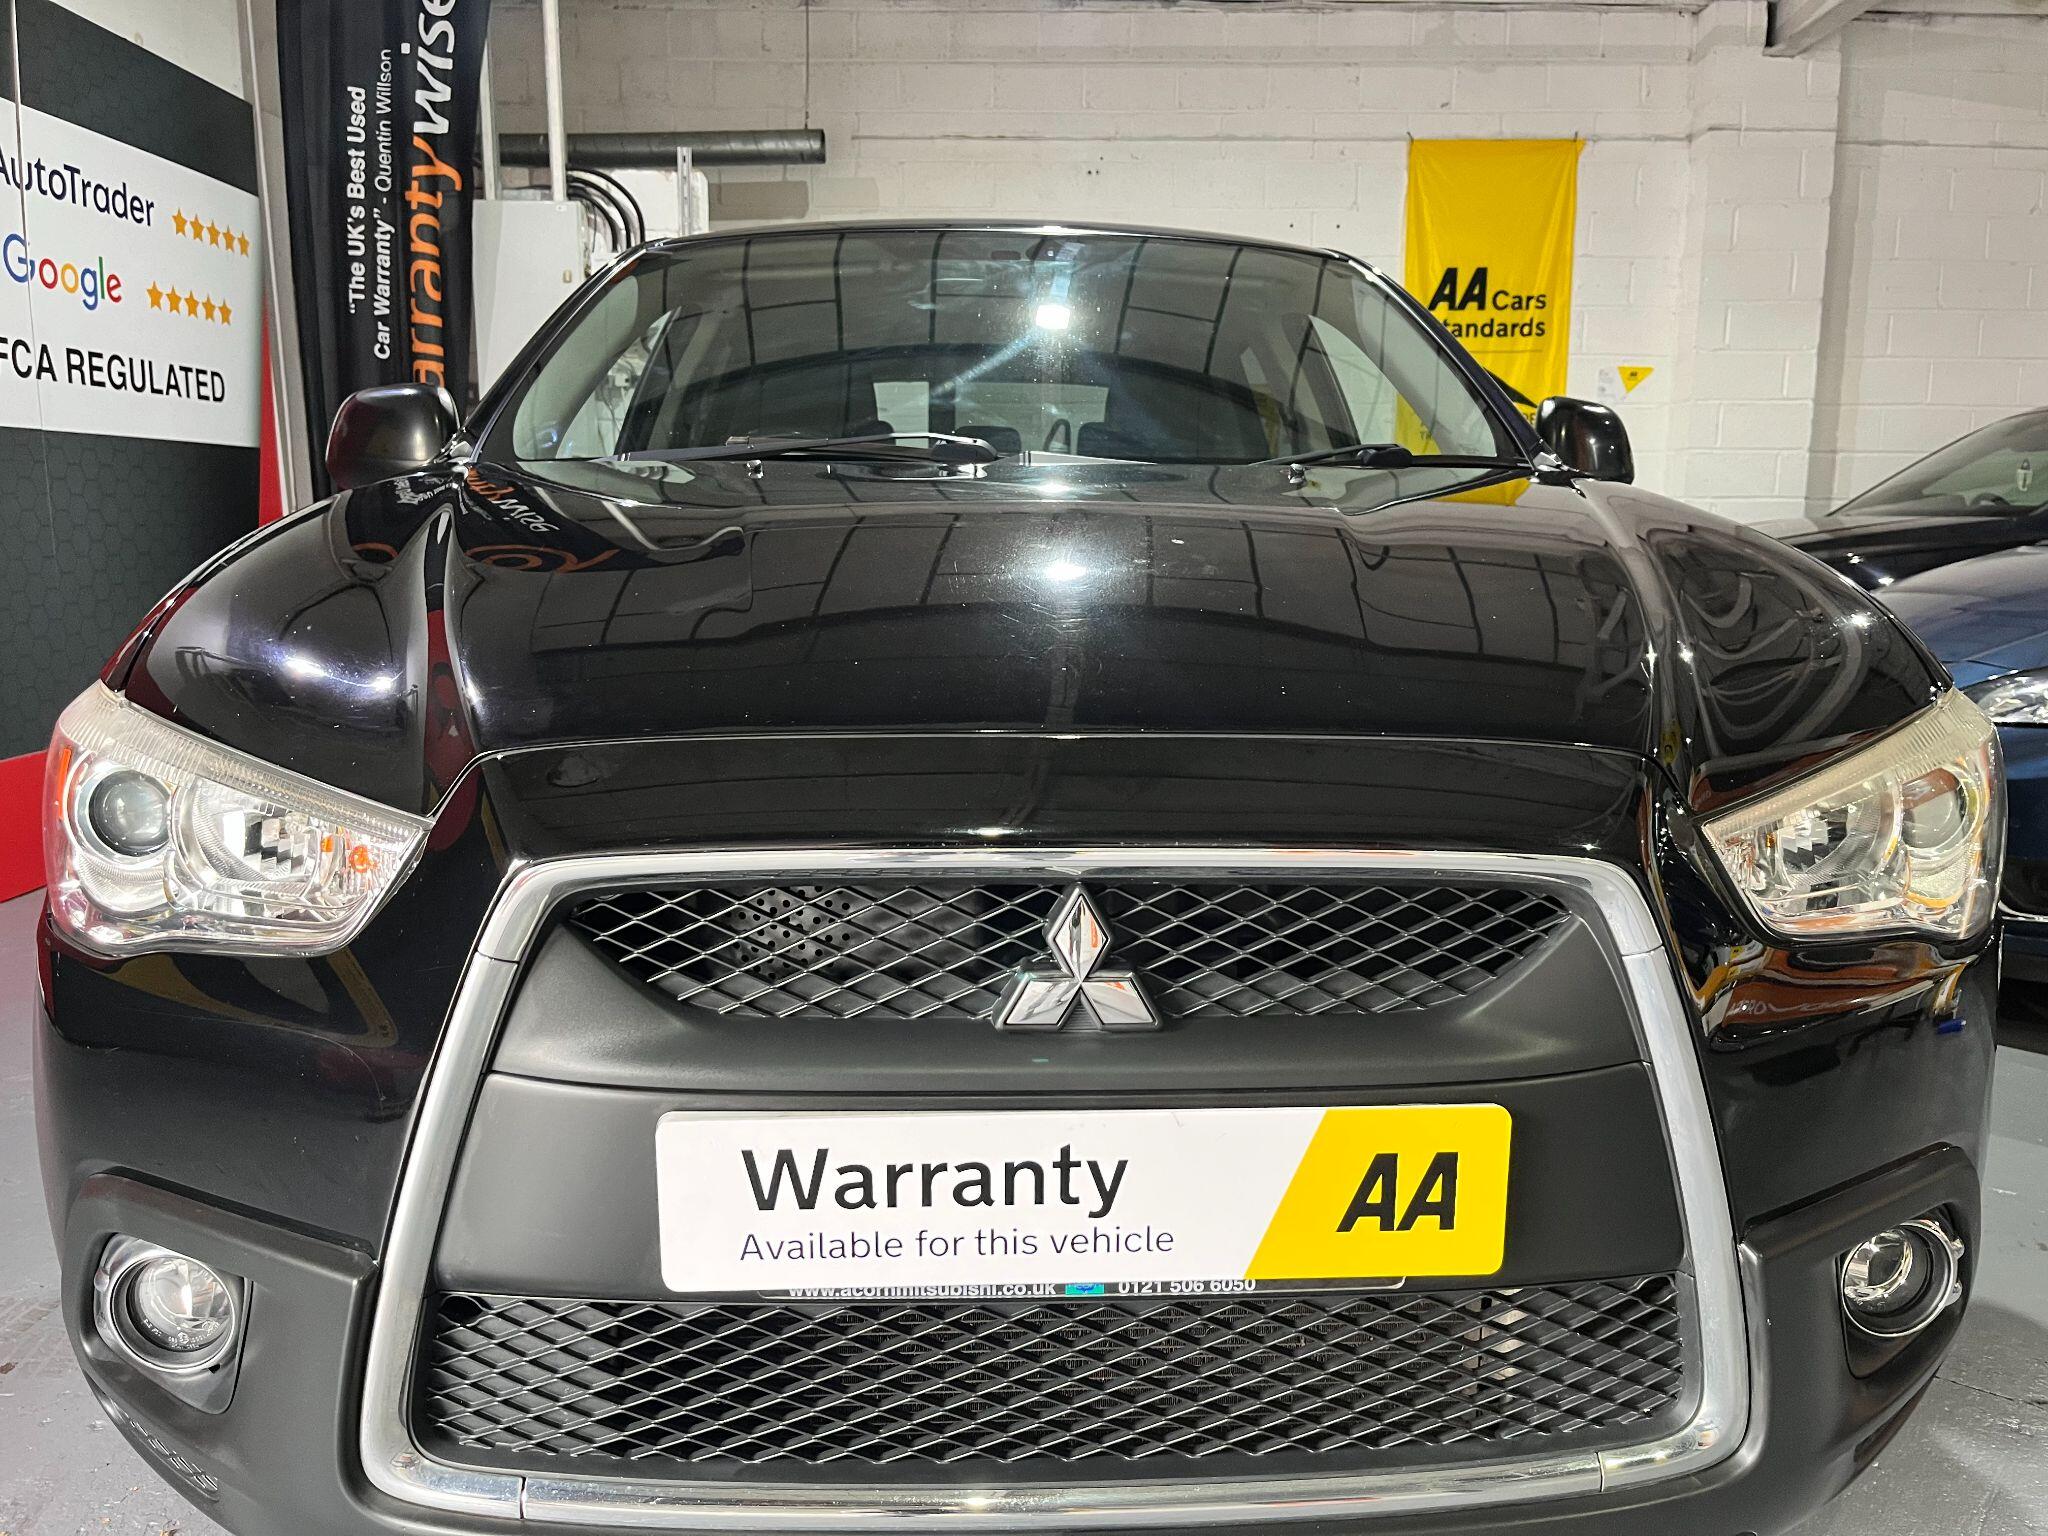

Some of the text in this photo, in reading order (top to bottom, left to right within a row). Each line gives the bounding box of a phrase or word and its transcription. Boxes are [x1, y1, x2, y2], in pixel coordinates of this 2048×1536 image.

[376, 49, 392, 114] Willson
[346, 86, 366, 143] Used
[346, 149, 366, 200] Best
[374, 120, 392, 192] Quentin
[0, 145, 155, 227] AutoTrader
[401, 0, 462, 388] arrantywise
[347, 205, 366, 257] UK’s
[3, 233, 122, 310] Google
[1428, 267, 1547, 311] AA Cars
[374, 321, 391, 360] Car
[1443, 318, 1546, 338] andards
[66, 347, 226, 402] REGULATED
[741, 1144, 1129, 1219] Warranty
[1336, 1152, 1458, 1232] AA
[740, 1226, 1174, 1260] Available for this vehicle
[1118, 1281, 1163, 1294] 0121
[1169, 1279, 1205, 1293] 506
[1210, 1278, 1256, 1292] 6050
